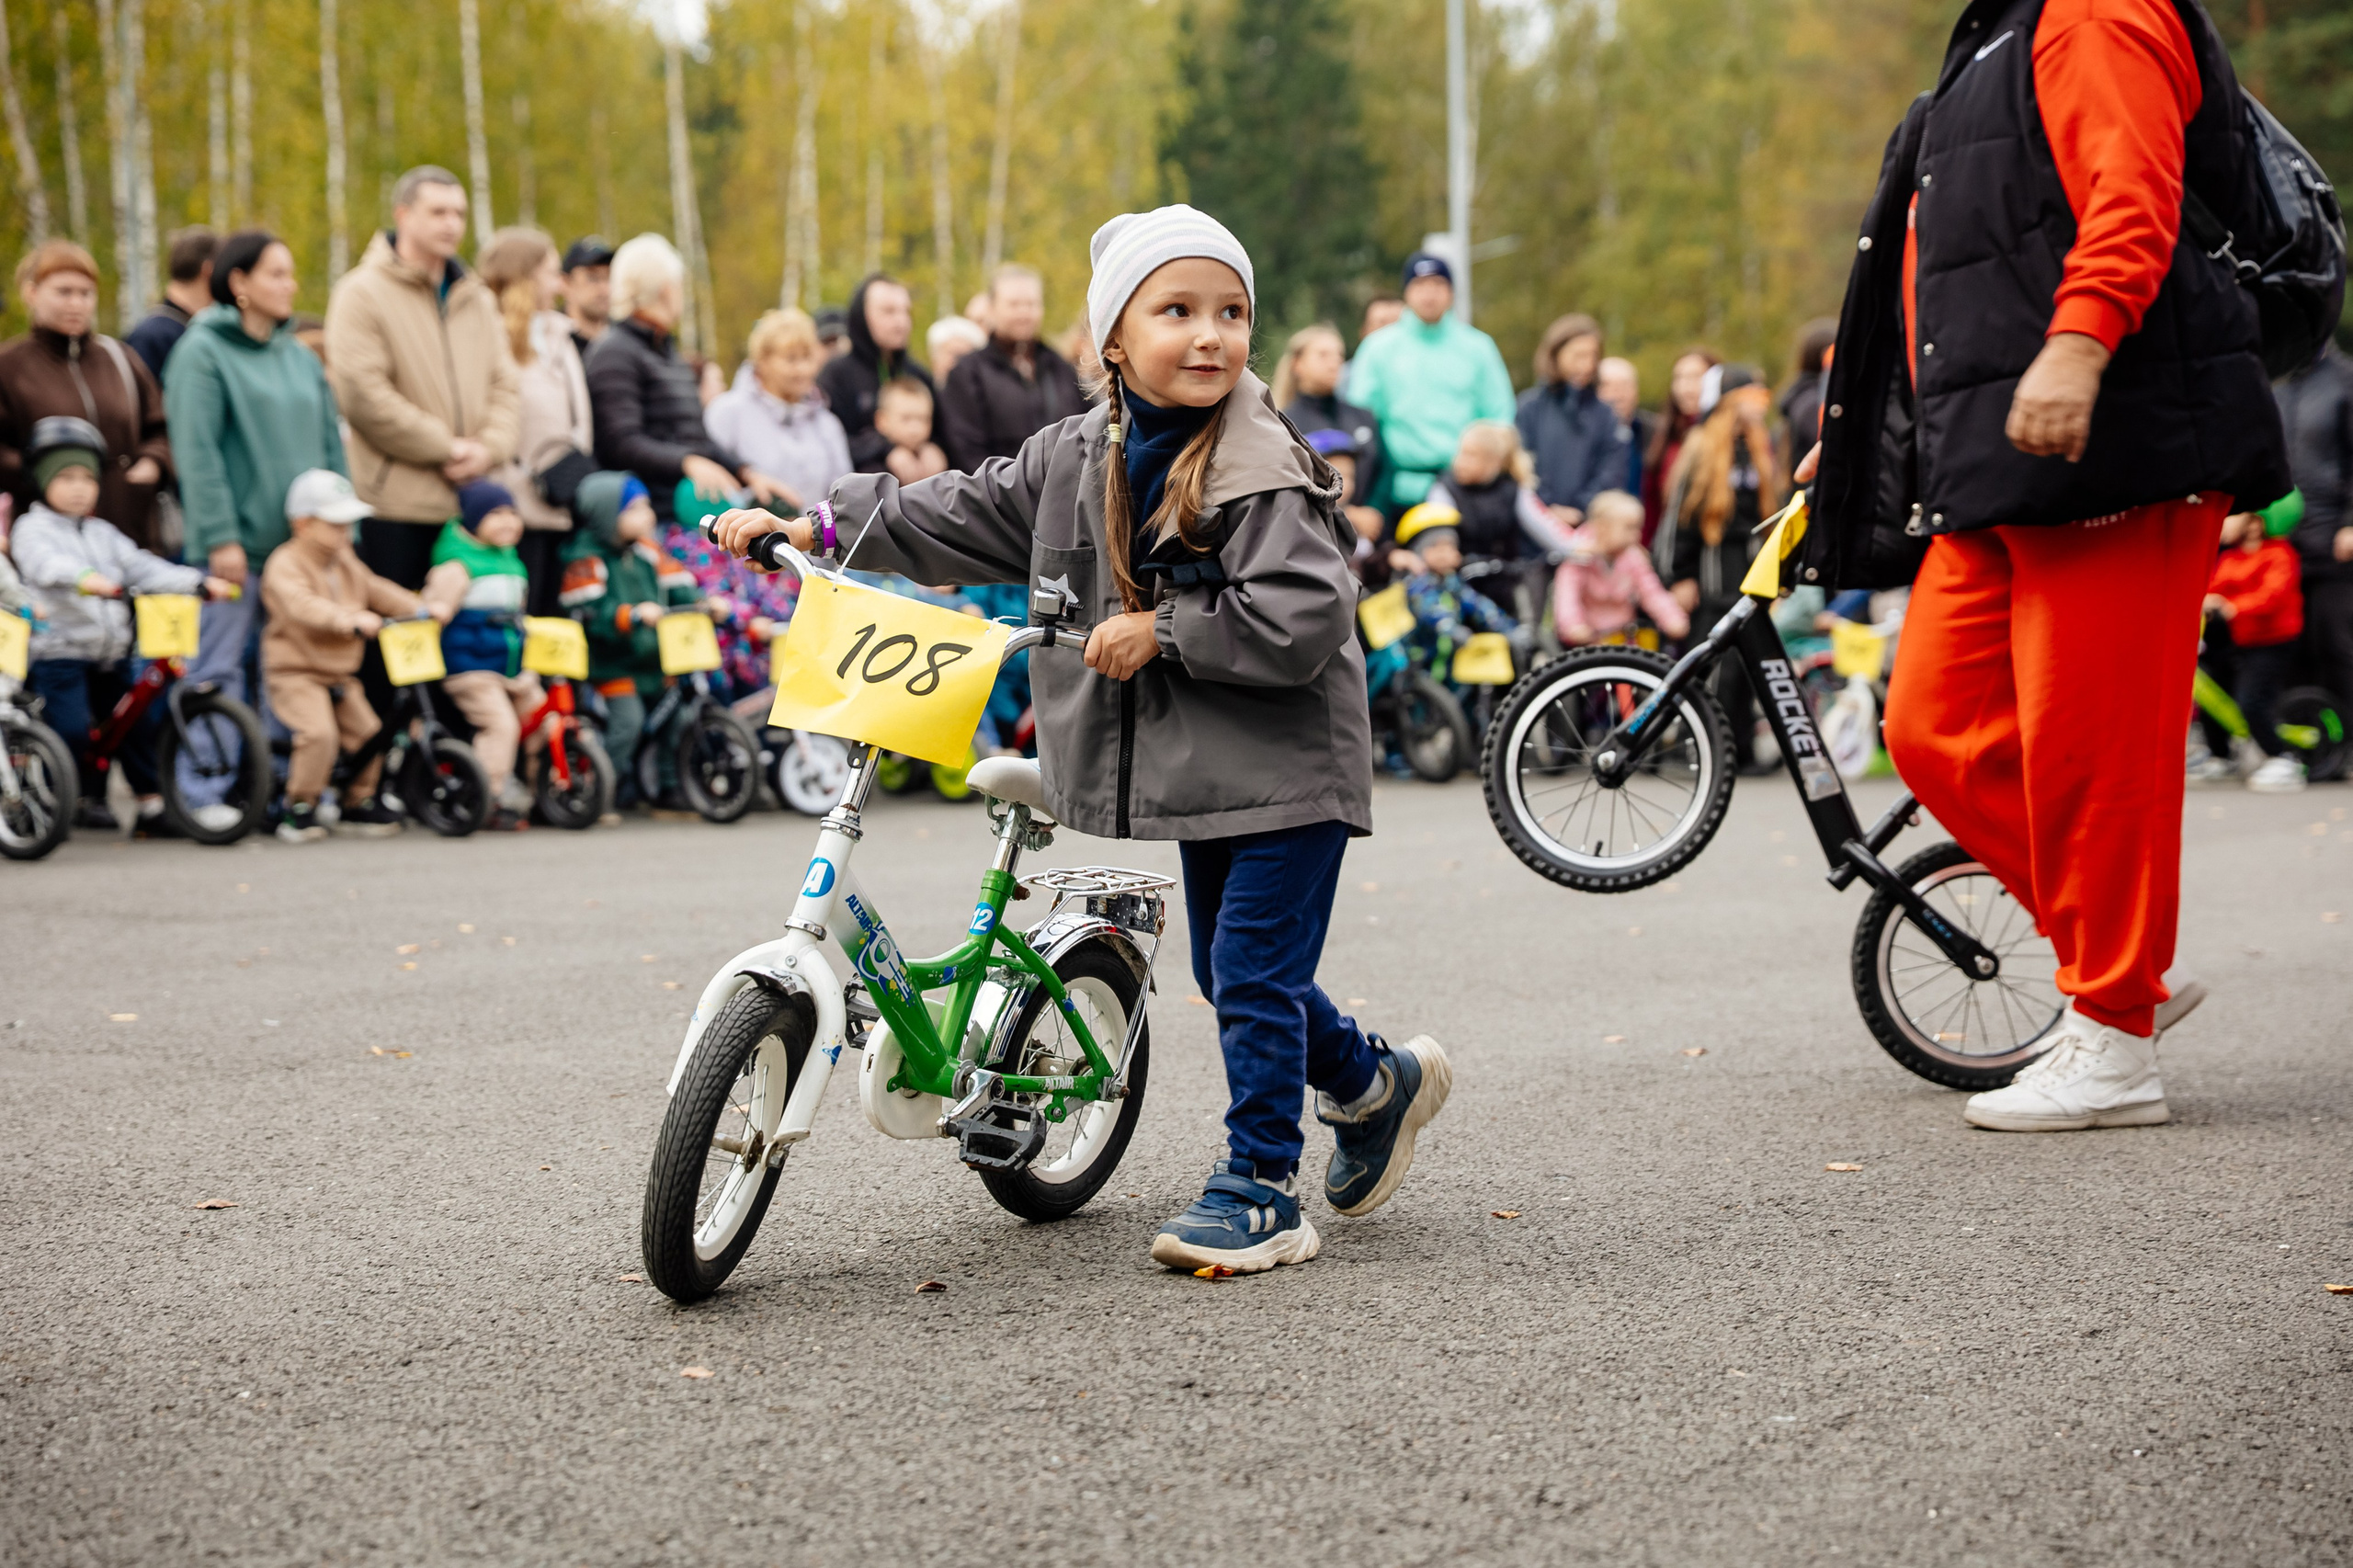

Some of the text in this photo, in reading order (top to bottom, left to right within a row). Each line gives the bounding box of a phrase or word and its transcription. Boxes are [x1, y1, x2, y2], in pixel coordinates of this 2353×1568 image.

[835, 622, 973, 697] 108
[801, 862, 828, 893] A
[845, 893, 873, 933] ALTAIR
[969, 907, 994, 931] 12
[1043, 1076, 1074, 1091] ALTAIR
